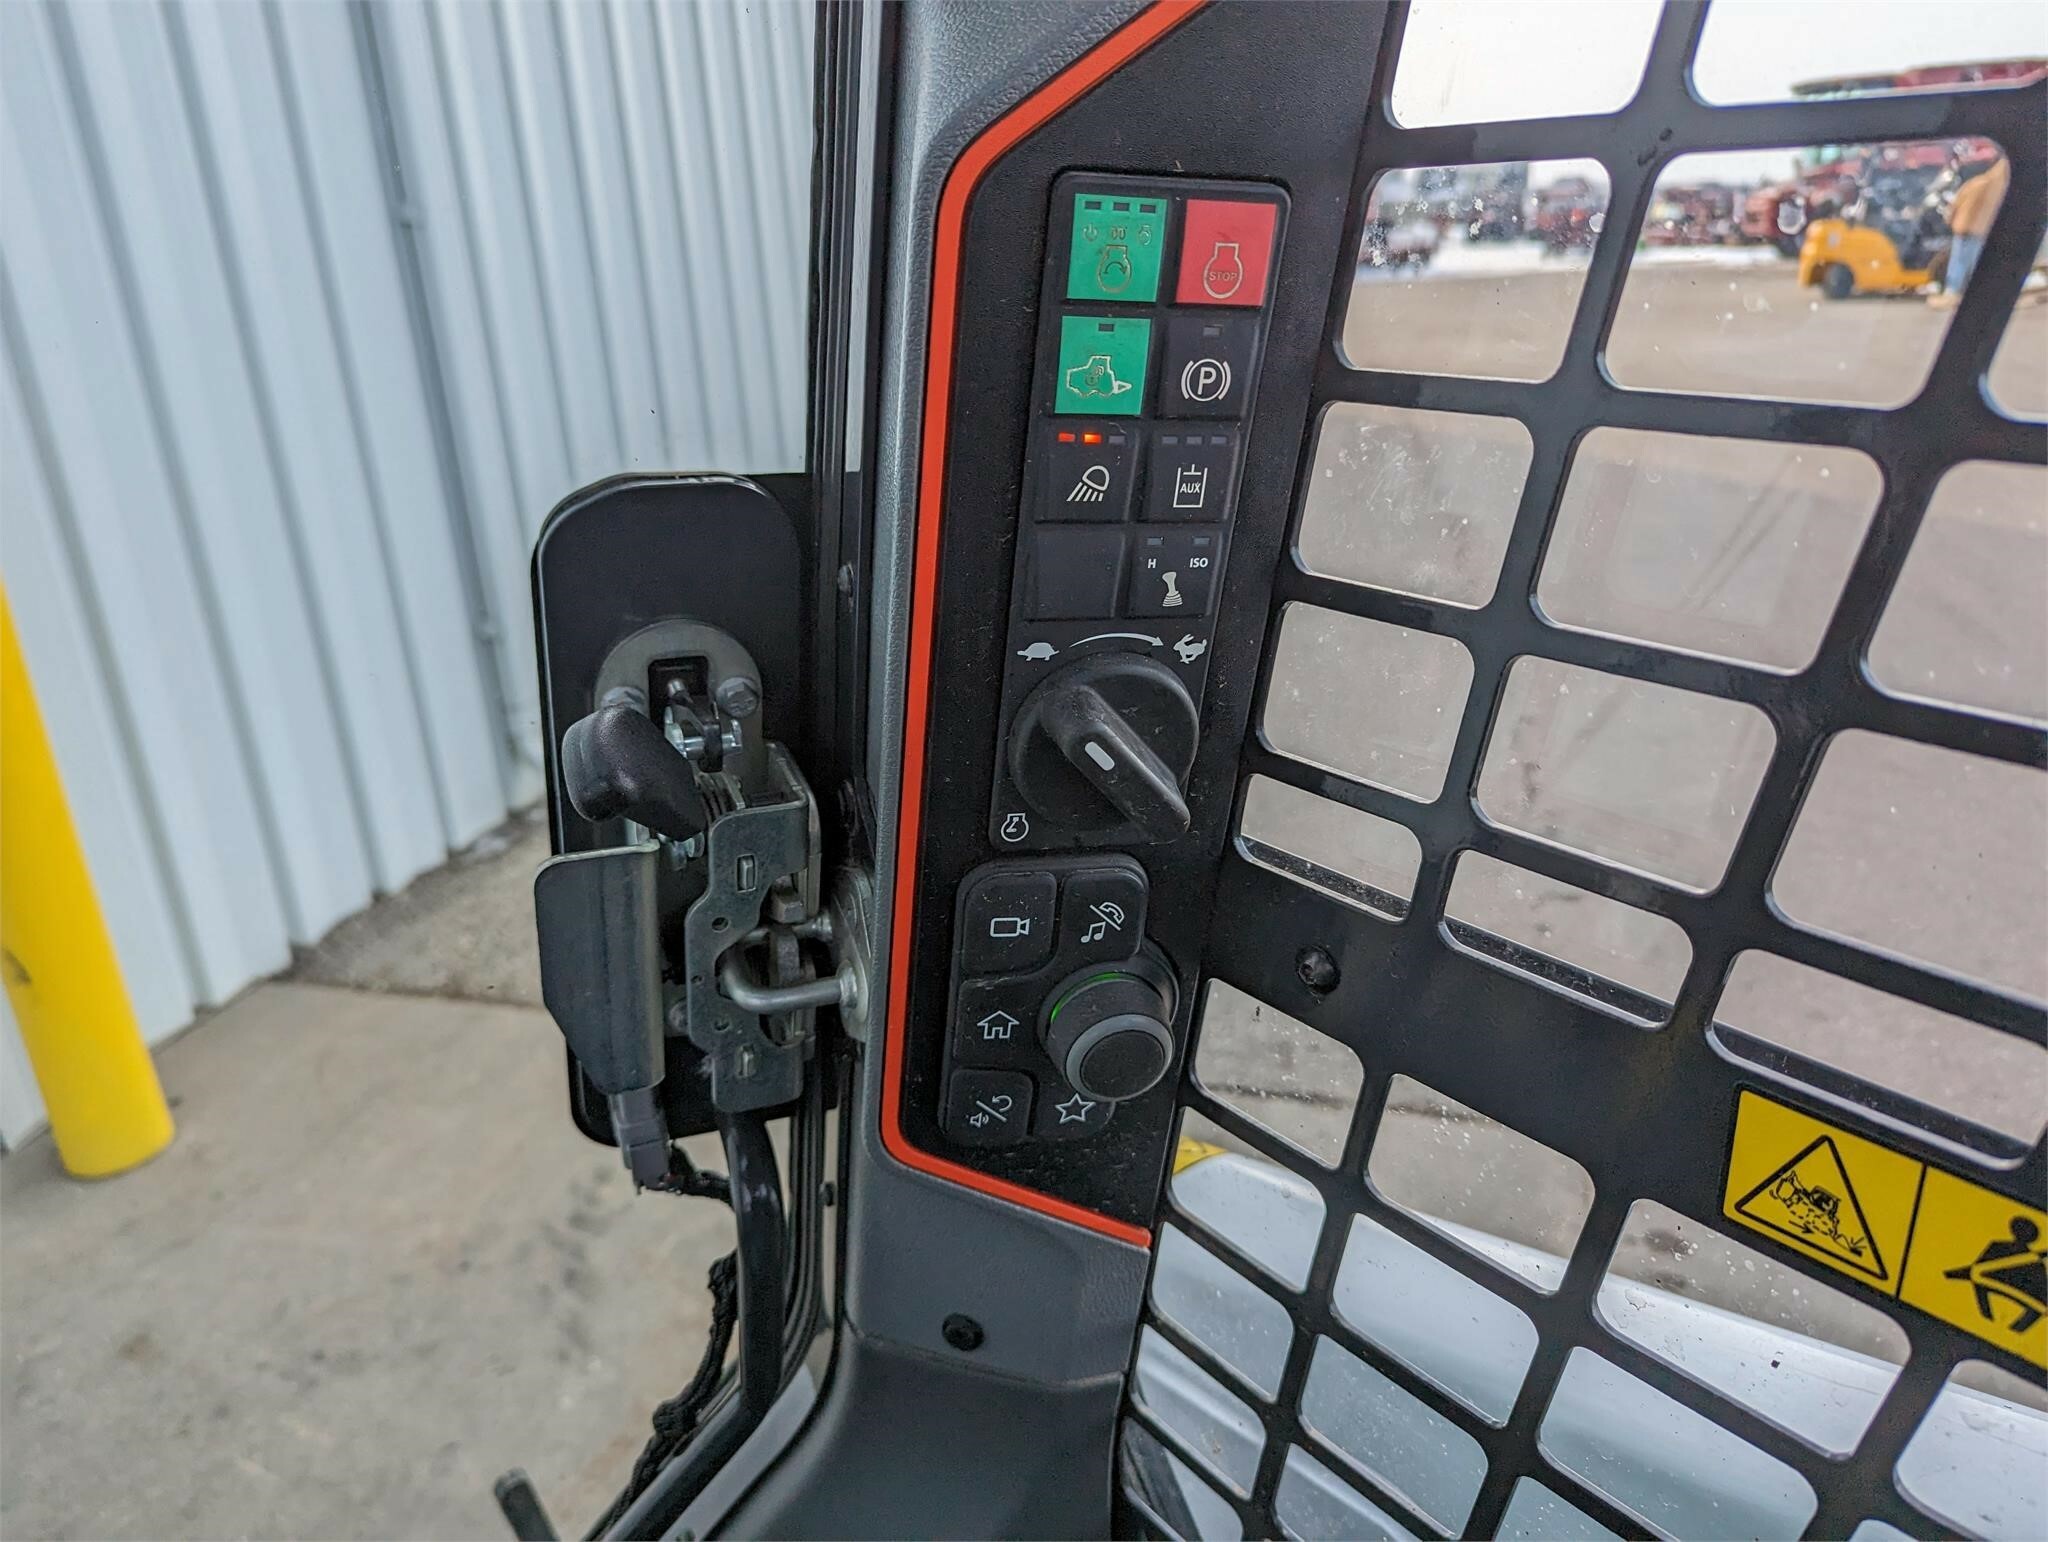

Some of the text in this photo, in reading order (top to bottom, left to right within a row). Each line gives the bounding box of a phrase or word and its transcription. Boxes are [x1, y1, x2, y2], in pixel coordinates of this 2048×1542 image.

[1208, 271, 1238, 282] STOP
[1197, 367, 1217, 395] P
[1179, 482, 1202, 494] AUX
[1147, 557, 1209, 569] H ISO
